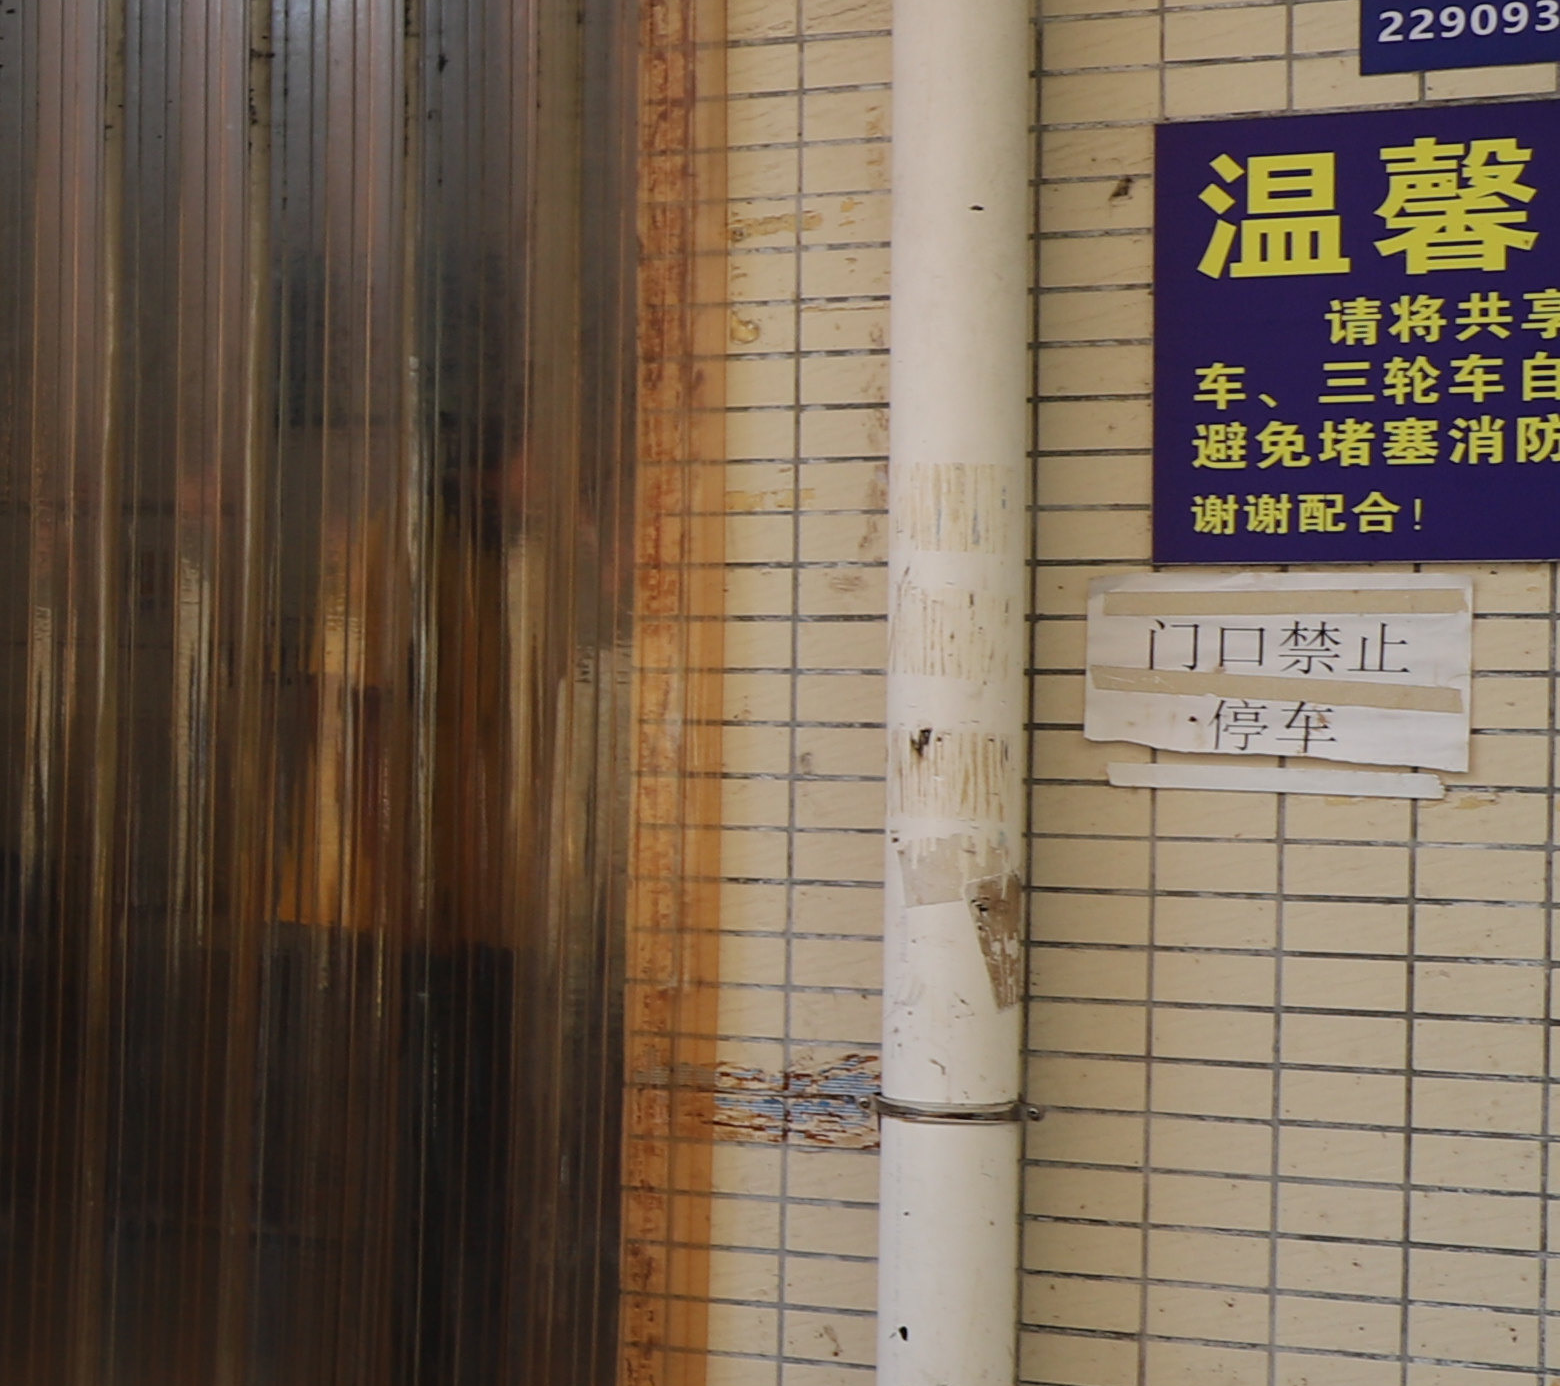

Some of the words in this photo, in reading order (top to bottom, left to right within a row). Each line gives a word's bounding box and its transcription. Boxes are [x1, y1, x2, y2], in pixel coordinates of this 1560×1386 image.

[1377, 0, 1560, 43] 229093
[1197, 136, 1539, 279] 温馨
[1325, 288, 1560, 345] 请将共享
[1194, 351, 1560, 410] 车、三轮车自
[1193, 413, 1560, 470] 避免堵塞消防
[1147, 618, 1411, 676] 门口禁止
[1207, 698, 1337, 755] 停车
